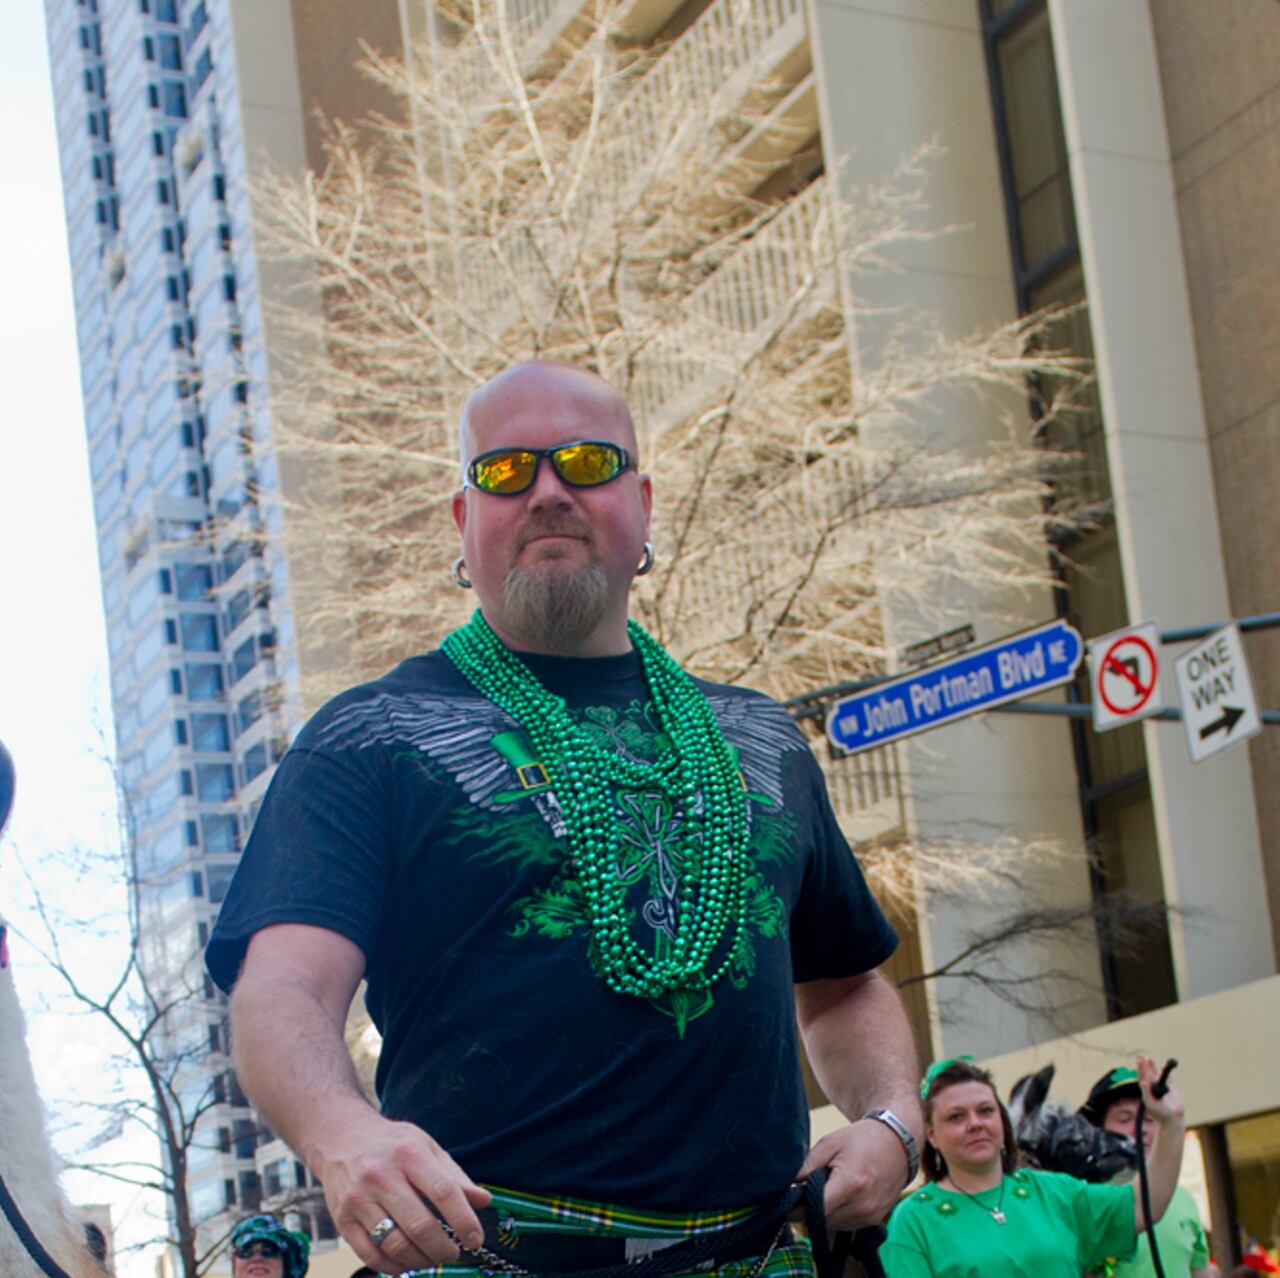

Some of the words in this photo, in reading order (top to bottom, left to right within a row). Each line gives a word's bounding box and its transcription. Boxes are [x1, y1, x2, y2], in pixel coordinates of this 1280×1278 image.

[1187, 636, 1231, 682] ONE
[838, 715, 859, 736] NW
[863, 696, 908, 738] John
[909, 666, 995, 719] Portman
[996, 640, 1047, 690] Blvd
[1047, 638, 1068, 665] NE
[1190, 667, 1235, 711] WAY
